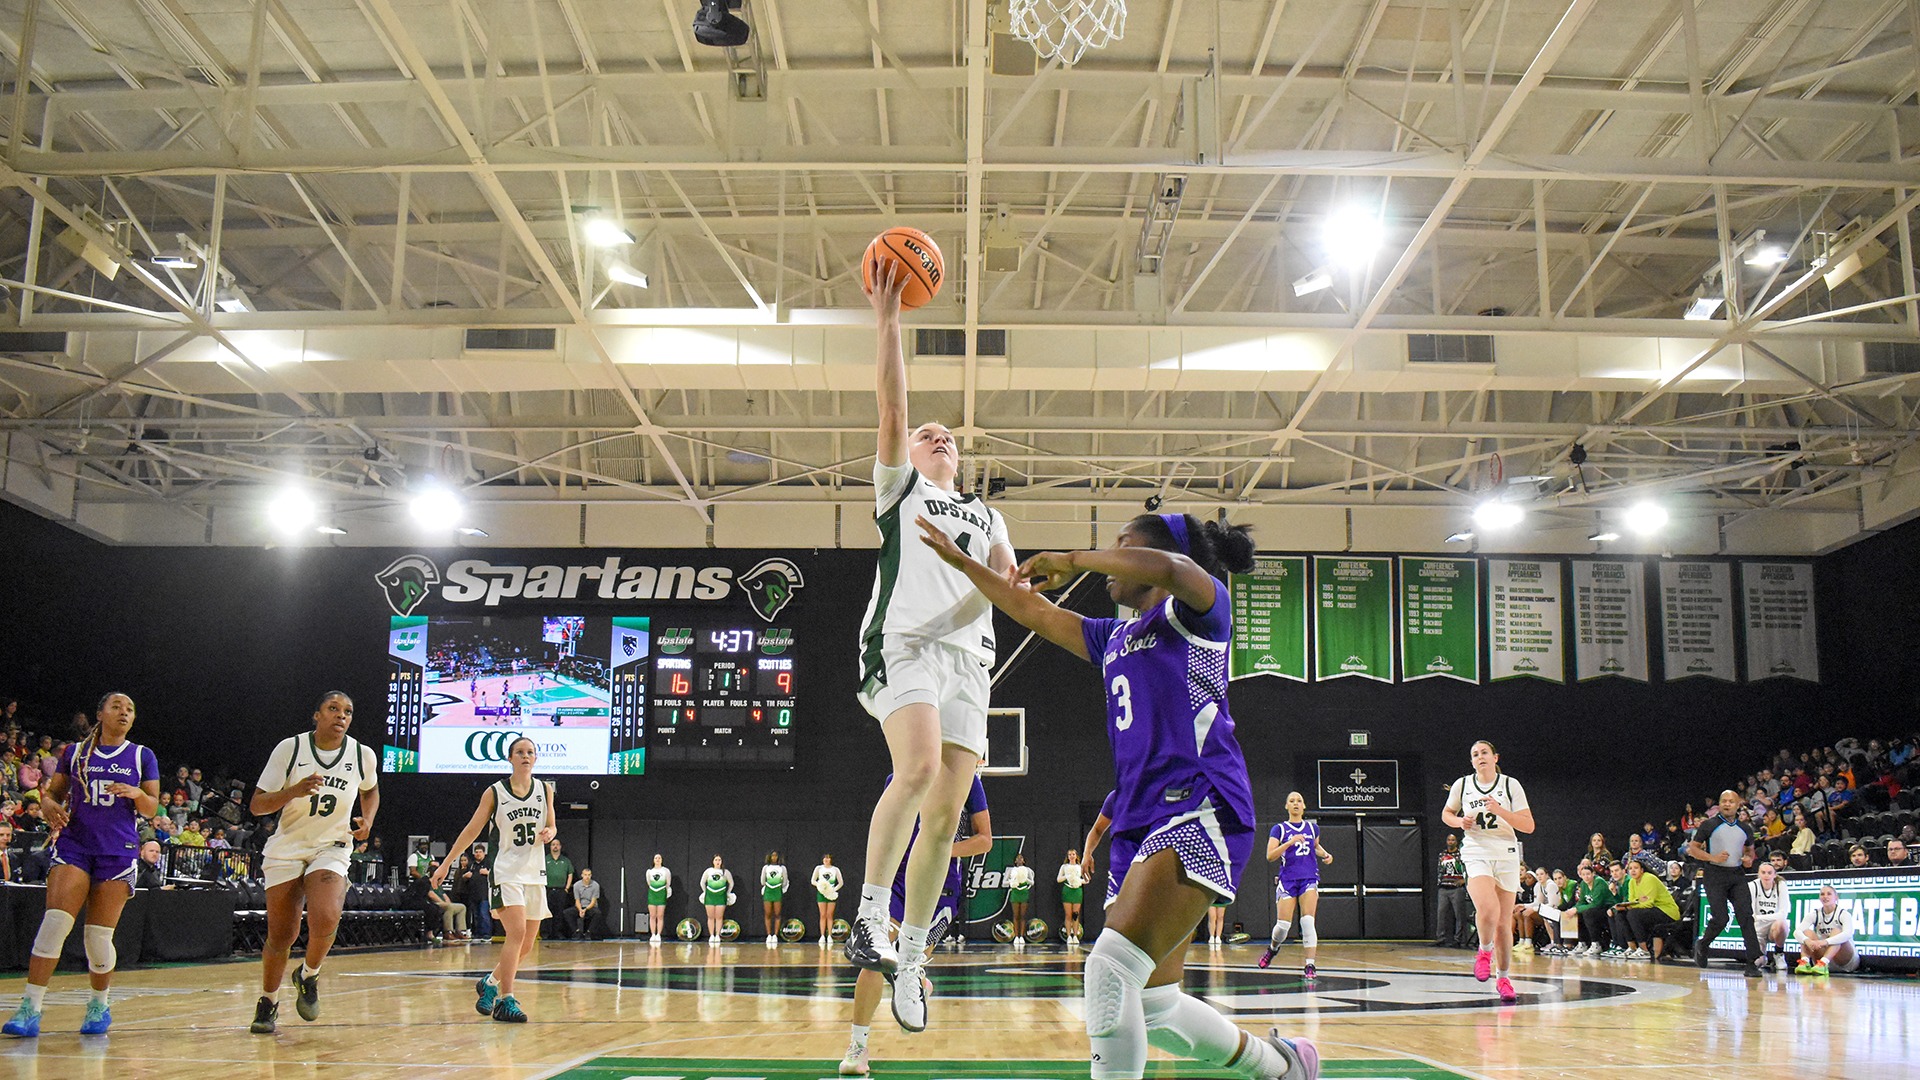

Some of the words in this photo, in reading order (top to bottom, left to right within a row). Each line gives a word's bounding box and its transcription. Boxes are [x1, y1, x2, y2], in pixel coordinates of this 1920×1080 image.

[904, 239, 941, 287] Wilson
[442, 556, 733, 606] Spartans
[657, 636, 694, 647] Upstate
[711, 630, 753, 652] 4:37
[757, 636, 794, 648] Upstate
[1120, 632, 1157, 657] Scott
[657, 659, 692, 669] SPARTANS
[758, 659, 792, 669] SCOTTIES
[400, 672, 411, 680] PTS
[624, 674, 635, 682] PTS
[640, 674, 644, 682] F
[724, 673, 730, 687] 1
[389, 683, 397, 691] 13
[402, 683, 408, 691] 0
[414, 683, 419, 691] 1
[671, 673, 689, 693] 16
[777, 673, 790, 693] 9
[614, 685, 620, 693] 0
[626, 685, 632, 693] 0
[639, 685, 644, 693] 0
[387, 694, 397, 702] 35
[402, 694, 407, 702] 9
[413, 694, 419, 702] 0
[615, 696, 619, 704] 1
[626, 696, 632, 704] 0
[639, 696, 644, 704] 0
[703, 699, 724, 707] PLAYER
[730, 699, 747, 707] FOULS
[1111, 674, 1133, 732] 3
[389, 705, 394, 713] 4
[401, 705, 407, 713] 0
[413, 705, 418, 713] 0
[613, 707, 621, 715] 15
[626, 707, 631, 715] 0
[638, 707, 644, 715] 0
[686, 709, 694, 720] 4
[386, 716, 396, 724] 42
[400, 716, 406, 724] 2
[412, 716, 418, 724] 0
[672, 709, 678, 724] 1
[753, 710, 761, 721] 4
[779, 709, 790, 725] 0
[612, 718, 621, 726] 25
[626, 718, 631, 726] 6
[638, 718, 643, 726] 0
[388, 727, 393, 735] 5
[400, 727, 405, 735] 2
[411, 727, 417, 735] 0
[613, 728, 618, 737] 3
[625, 728, 630, 737] 3
[637, 728, 643, 737] 0
[1353, 735, 1365, 744] EXIT
[537, 743, 567, 752] YTON
[107, 763, 132, 776] Scott
[323, 775, 348, 791] TATE
[90, 779, 115, 807] 15
[1327, 785, 1353, 794] Sports
[1355, 785, 1390, 793] Medicine
[1343, 793, 1375, 801] Institute
[309, 793, 337, 817] 13
[506, 807, 541, 821] UPSTATE
[1476, 812, 1498, 829] 42
[513, 822, 536, 846] 35
[1294, 841, 1310, 856] 25
[1900, 897, 1920, 936] B
